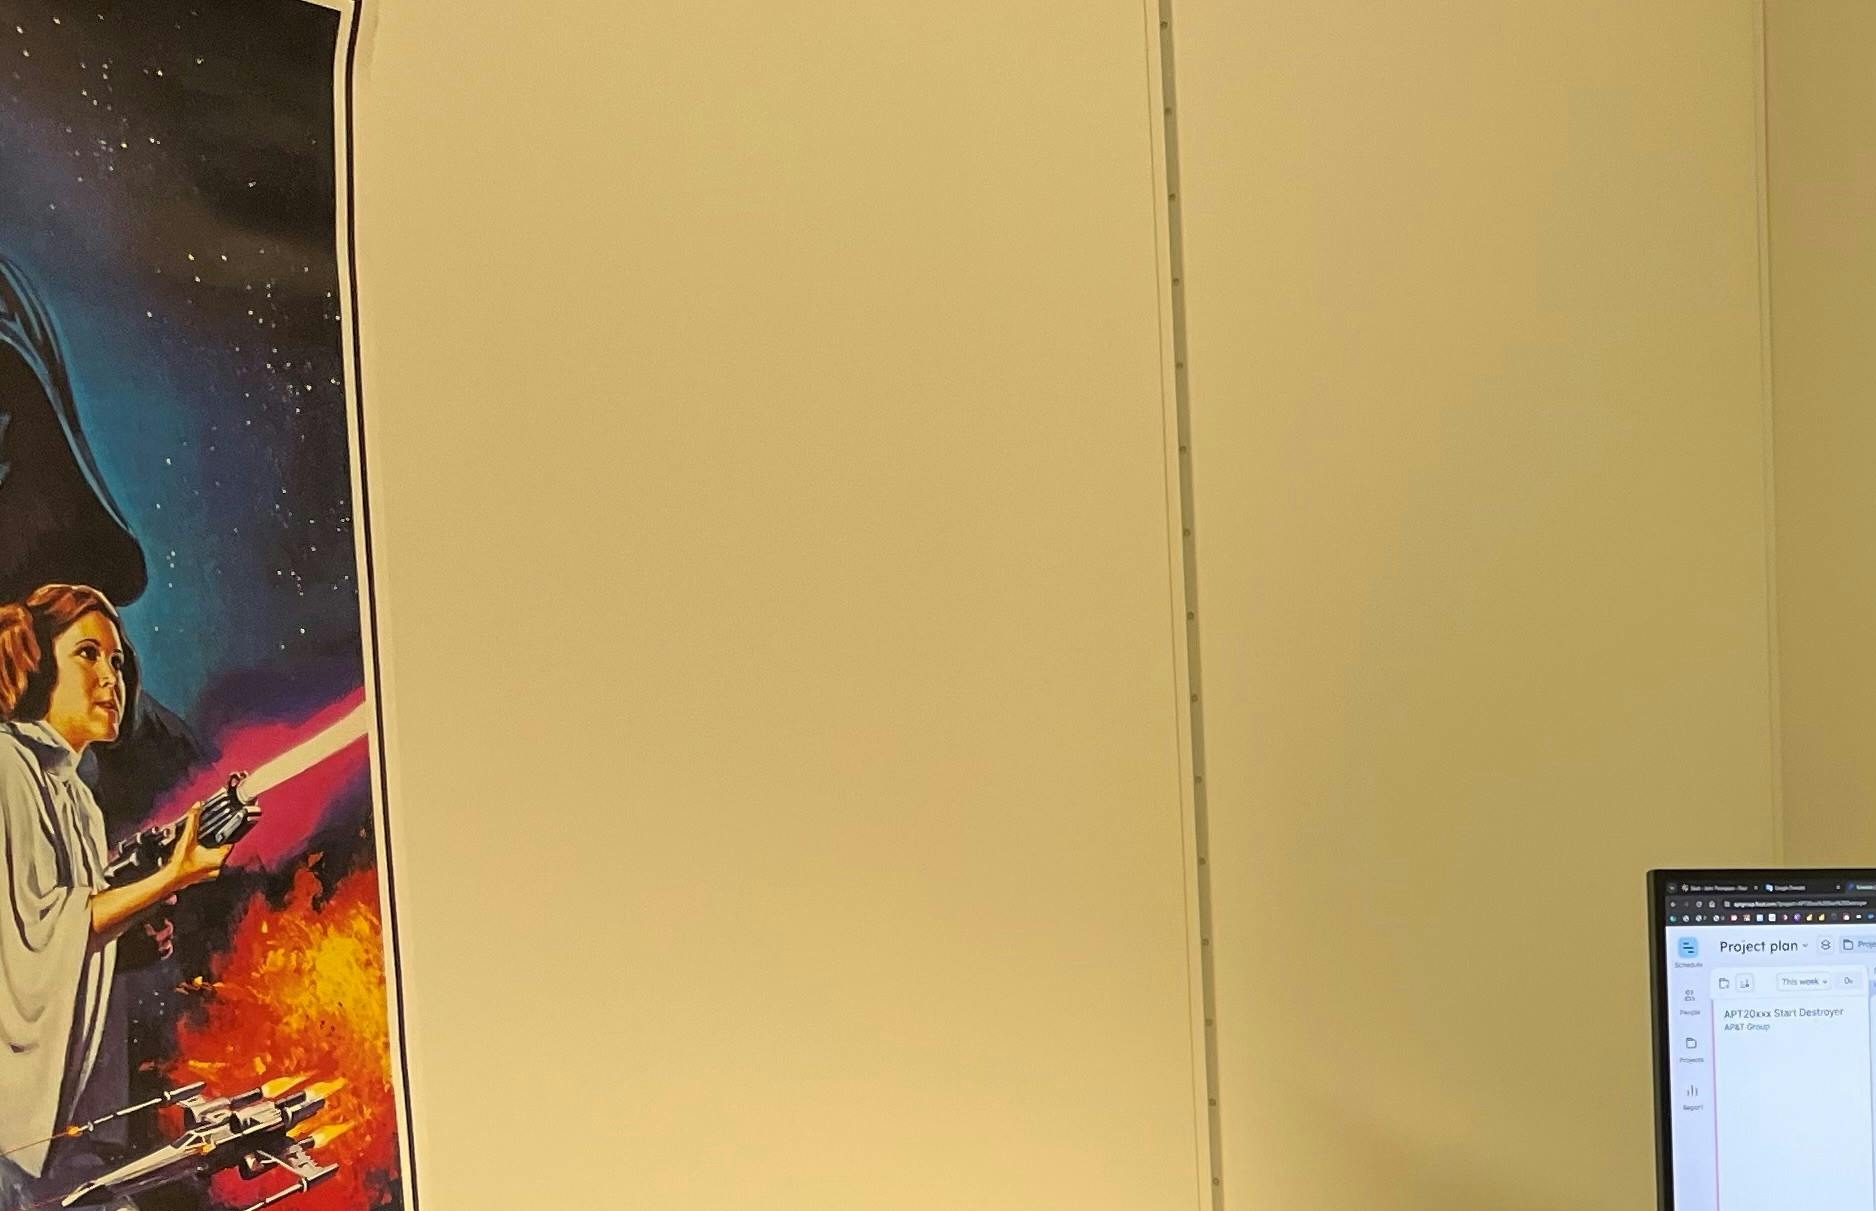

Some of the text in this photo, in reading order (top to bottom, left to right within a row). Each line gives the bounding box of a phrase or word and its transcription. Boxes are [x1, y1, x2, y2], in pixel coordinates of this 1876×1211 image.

[1720, 940, 1798, 955] Project plan
[1781, 977, 1820, 986] This week
[1774, 1008, 1797, 1018] Start
[1799, 1007, 1844, 1020] Destroyer
[1746, 1023, 1771, 1033] Group
